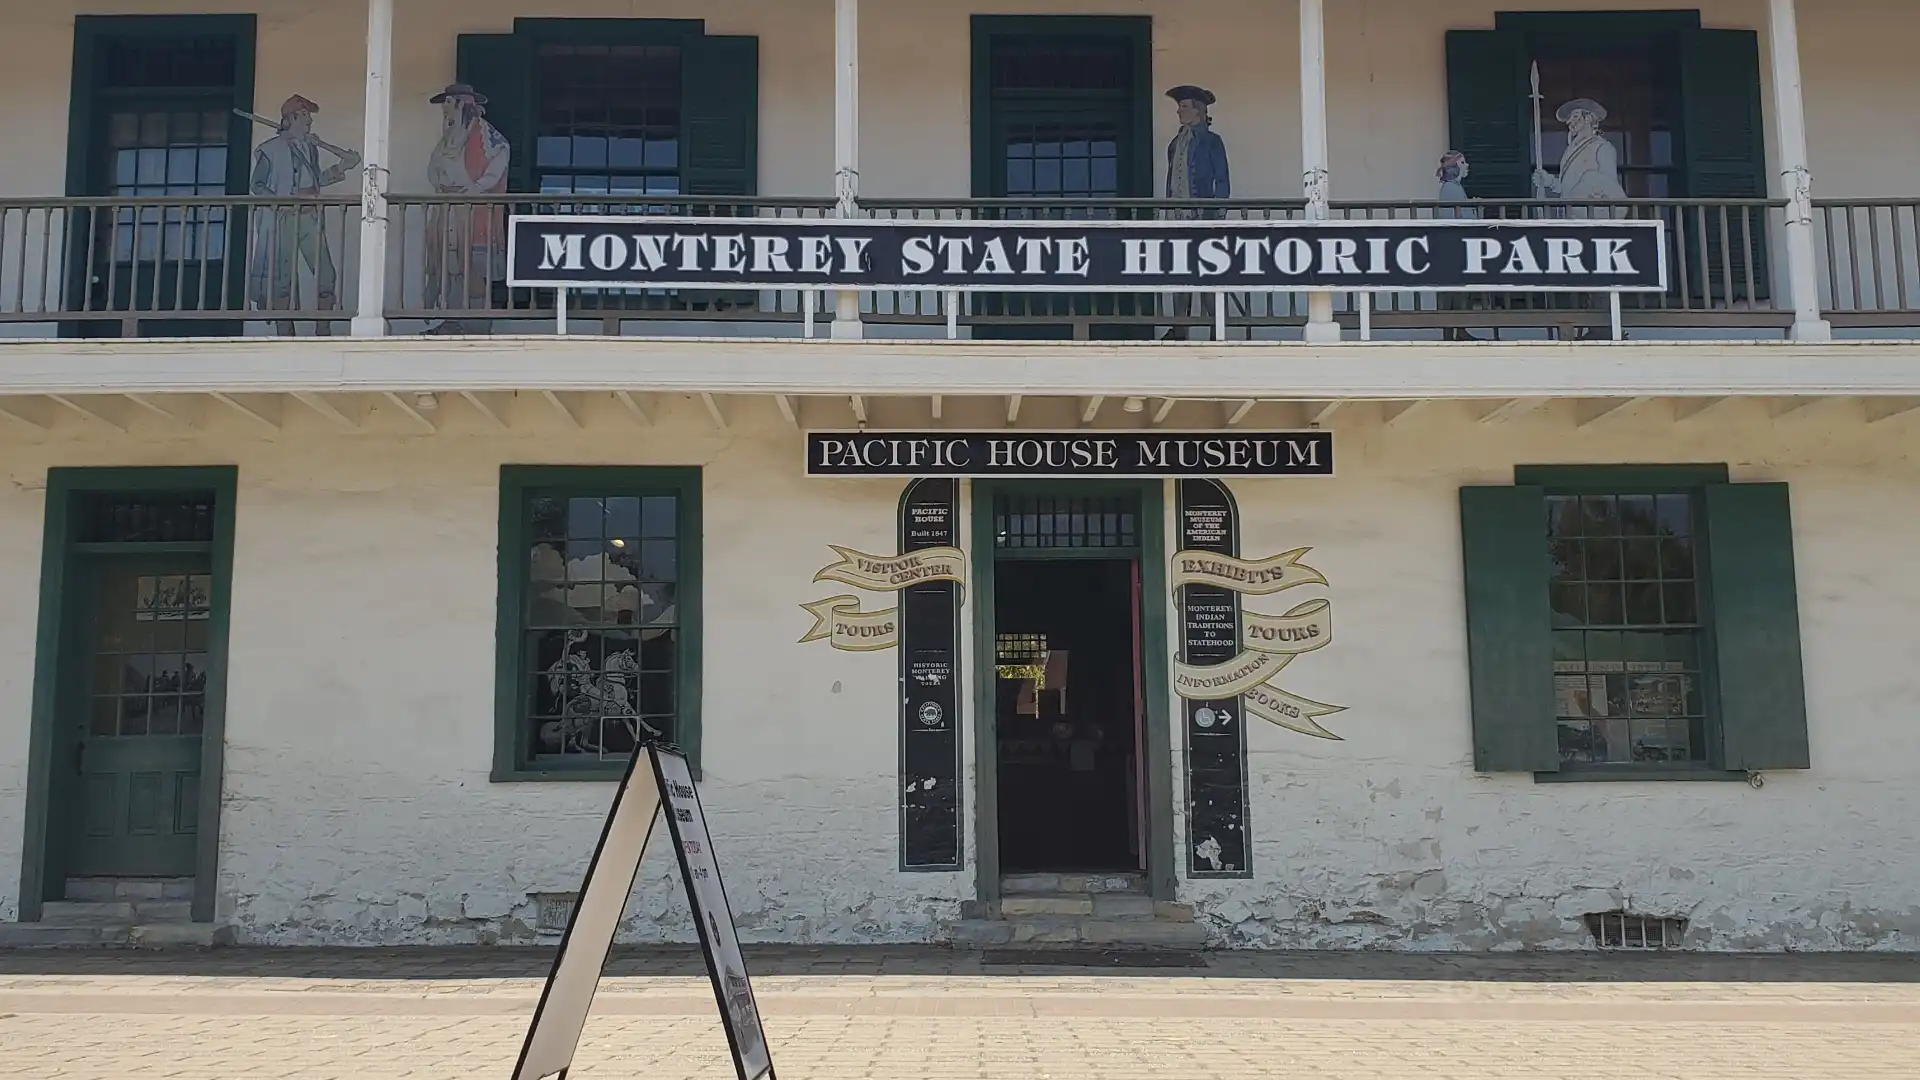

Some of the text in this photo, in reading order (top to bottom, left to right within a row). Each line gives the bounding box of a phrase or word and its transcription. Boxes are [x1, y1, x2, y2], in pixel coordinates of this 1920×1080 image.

[538, 232, 1640, 278] MONTEREY STATE HISTORIC PARK
[818, 438, 1322, 469] PACIFIC HOUSE MUSEUM
[857, 555, 924, 574] VISITOR
[889, 564, 954, 585] CENTER
[1181, 559, 1285, 584] EXHIBITS
[835, 621, 895, 638] TOURS
[1247, 623, 1321, 642] TOURS
[1176, 653, 1271, 688] INFORMATION
[1244, 688, 1300, 719] BOOKS
